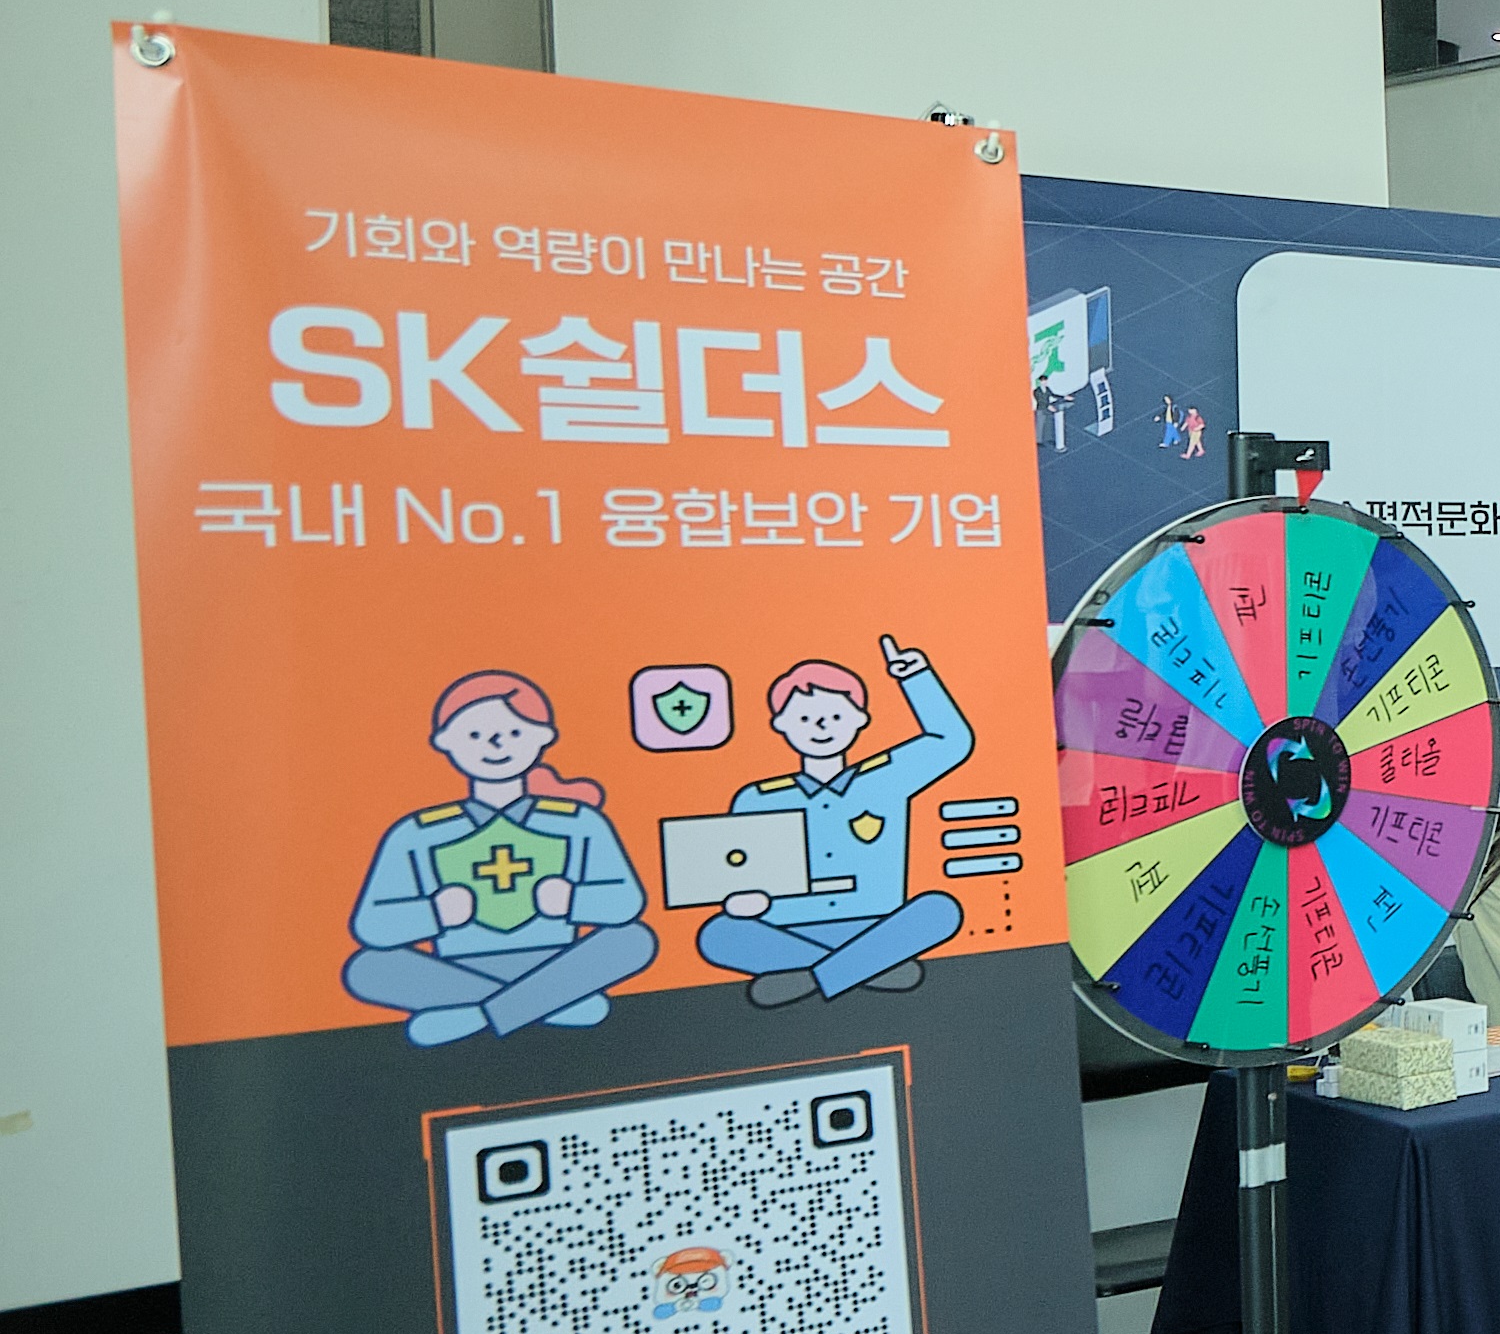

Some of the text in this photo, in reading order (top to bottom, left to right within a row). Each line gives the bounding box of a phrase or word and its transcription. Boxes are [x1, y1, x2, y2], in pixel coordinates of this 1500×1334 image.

[304, 208, 909, 300] 기회와 역량이 만나는 공간
[267, 304, 951, 448] SK쉴더스
[194, 480, 1002, 549] 국내 No.1 융합보안 기업
[1297, 571, 1332, 680] 기프티콘
[1151, 617, 1230, 709] 기프티콘
[1366, 653, 1450, 723] 기프티콘
[1380, 737, 1441, 784] 쿨타올
[1100, 781, 1200, 826] 기프티콘
[1371, 805, 1443, 857] 기프티콘
[1124, 861, 1170, 903] 펜
[1367, 885, 1403, 933] 펜
[1237, 895, 1281, 1005] 손선풍기
[1301, 876, 1344, 982] 기프티콘
